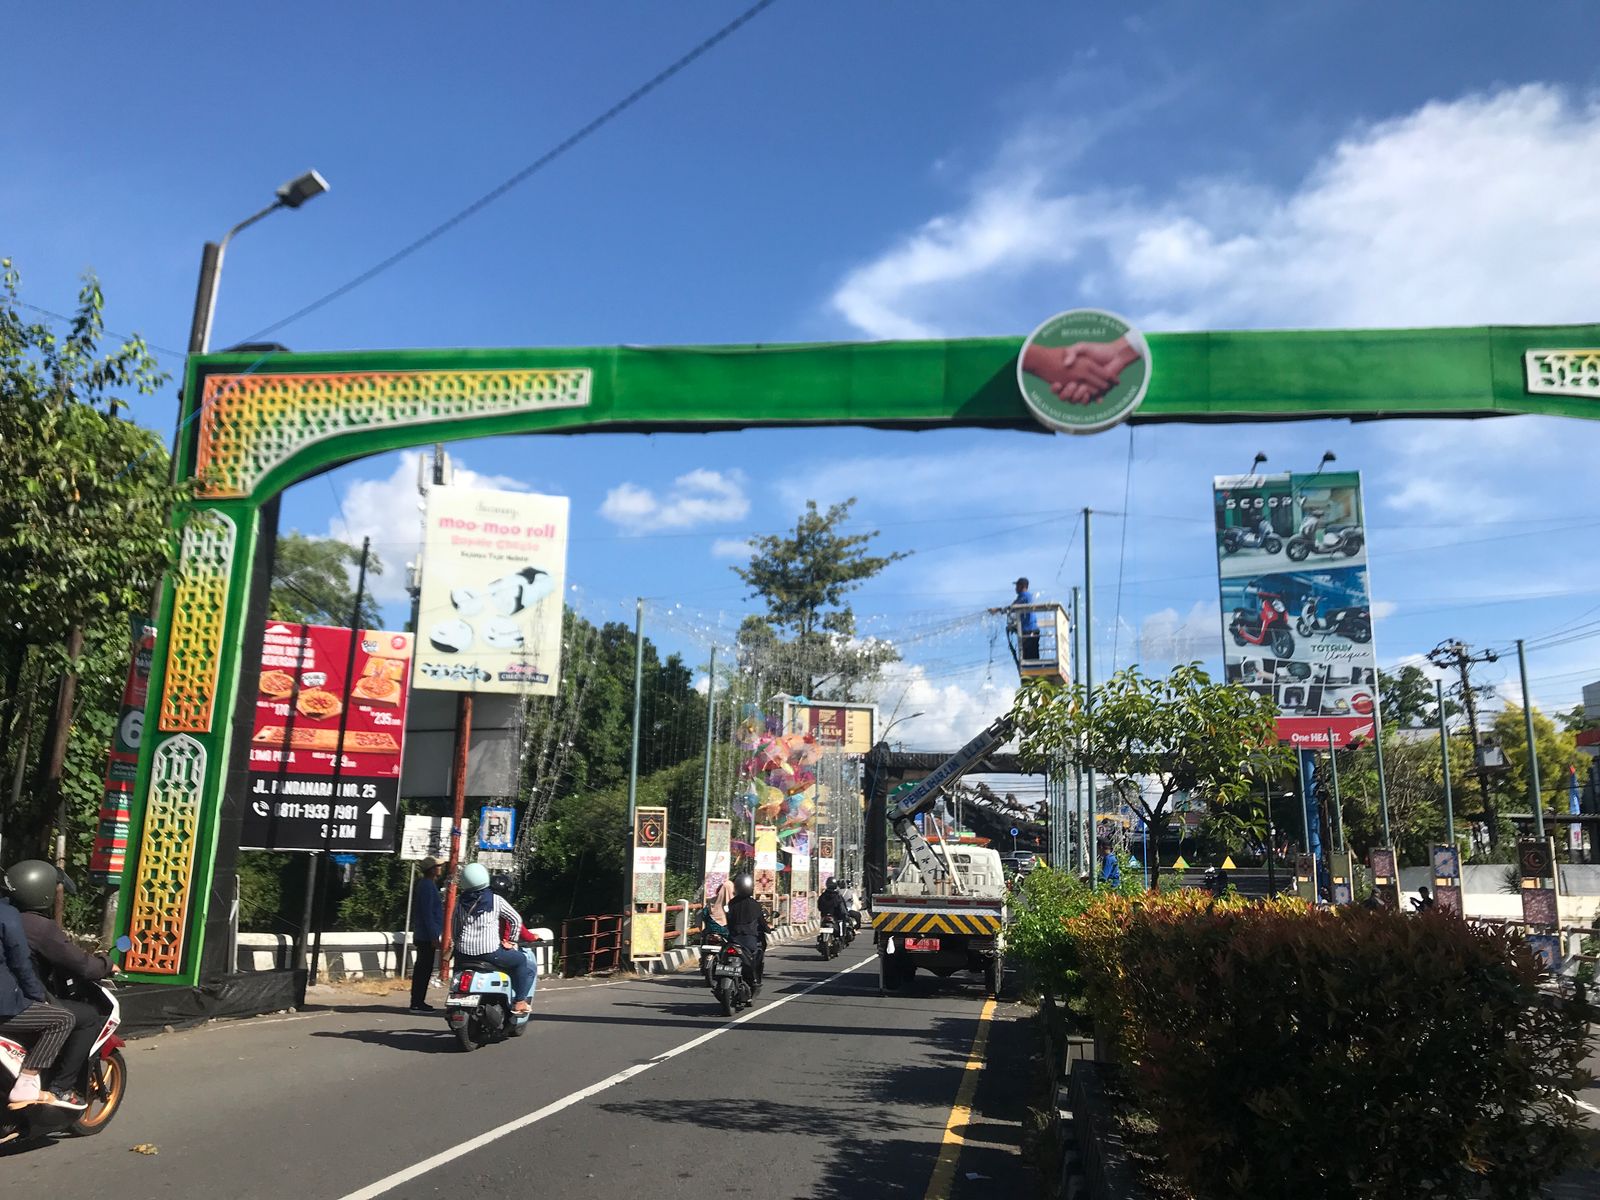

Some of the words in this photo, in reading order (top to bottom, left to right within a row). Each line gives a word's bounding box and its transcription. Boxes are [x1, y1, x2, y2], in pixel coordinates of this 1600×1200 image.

[1226, 496, 1306, 509] SCOOPY
[527, 524, 556, 538] roll
[1291, 733, 1310, 742] One
[253, 779, 269, 794] JL.
[342, 783, 360, 798] NO.
[362, 784, 377, 798] 25
[339, 824, 357, 839] KM
